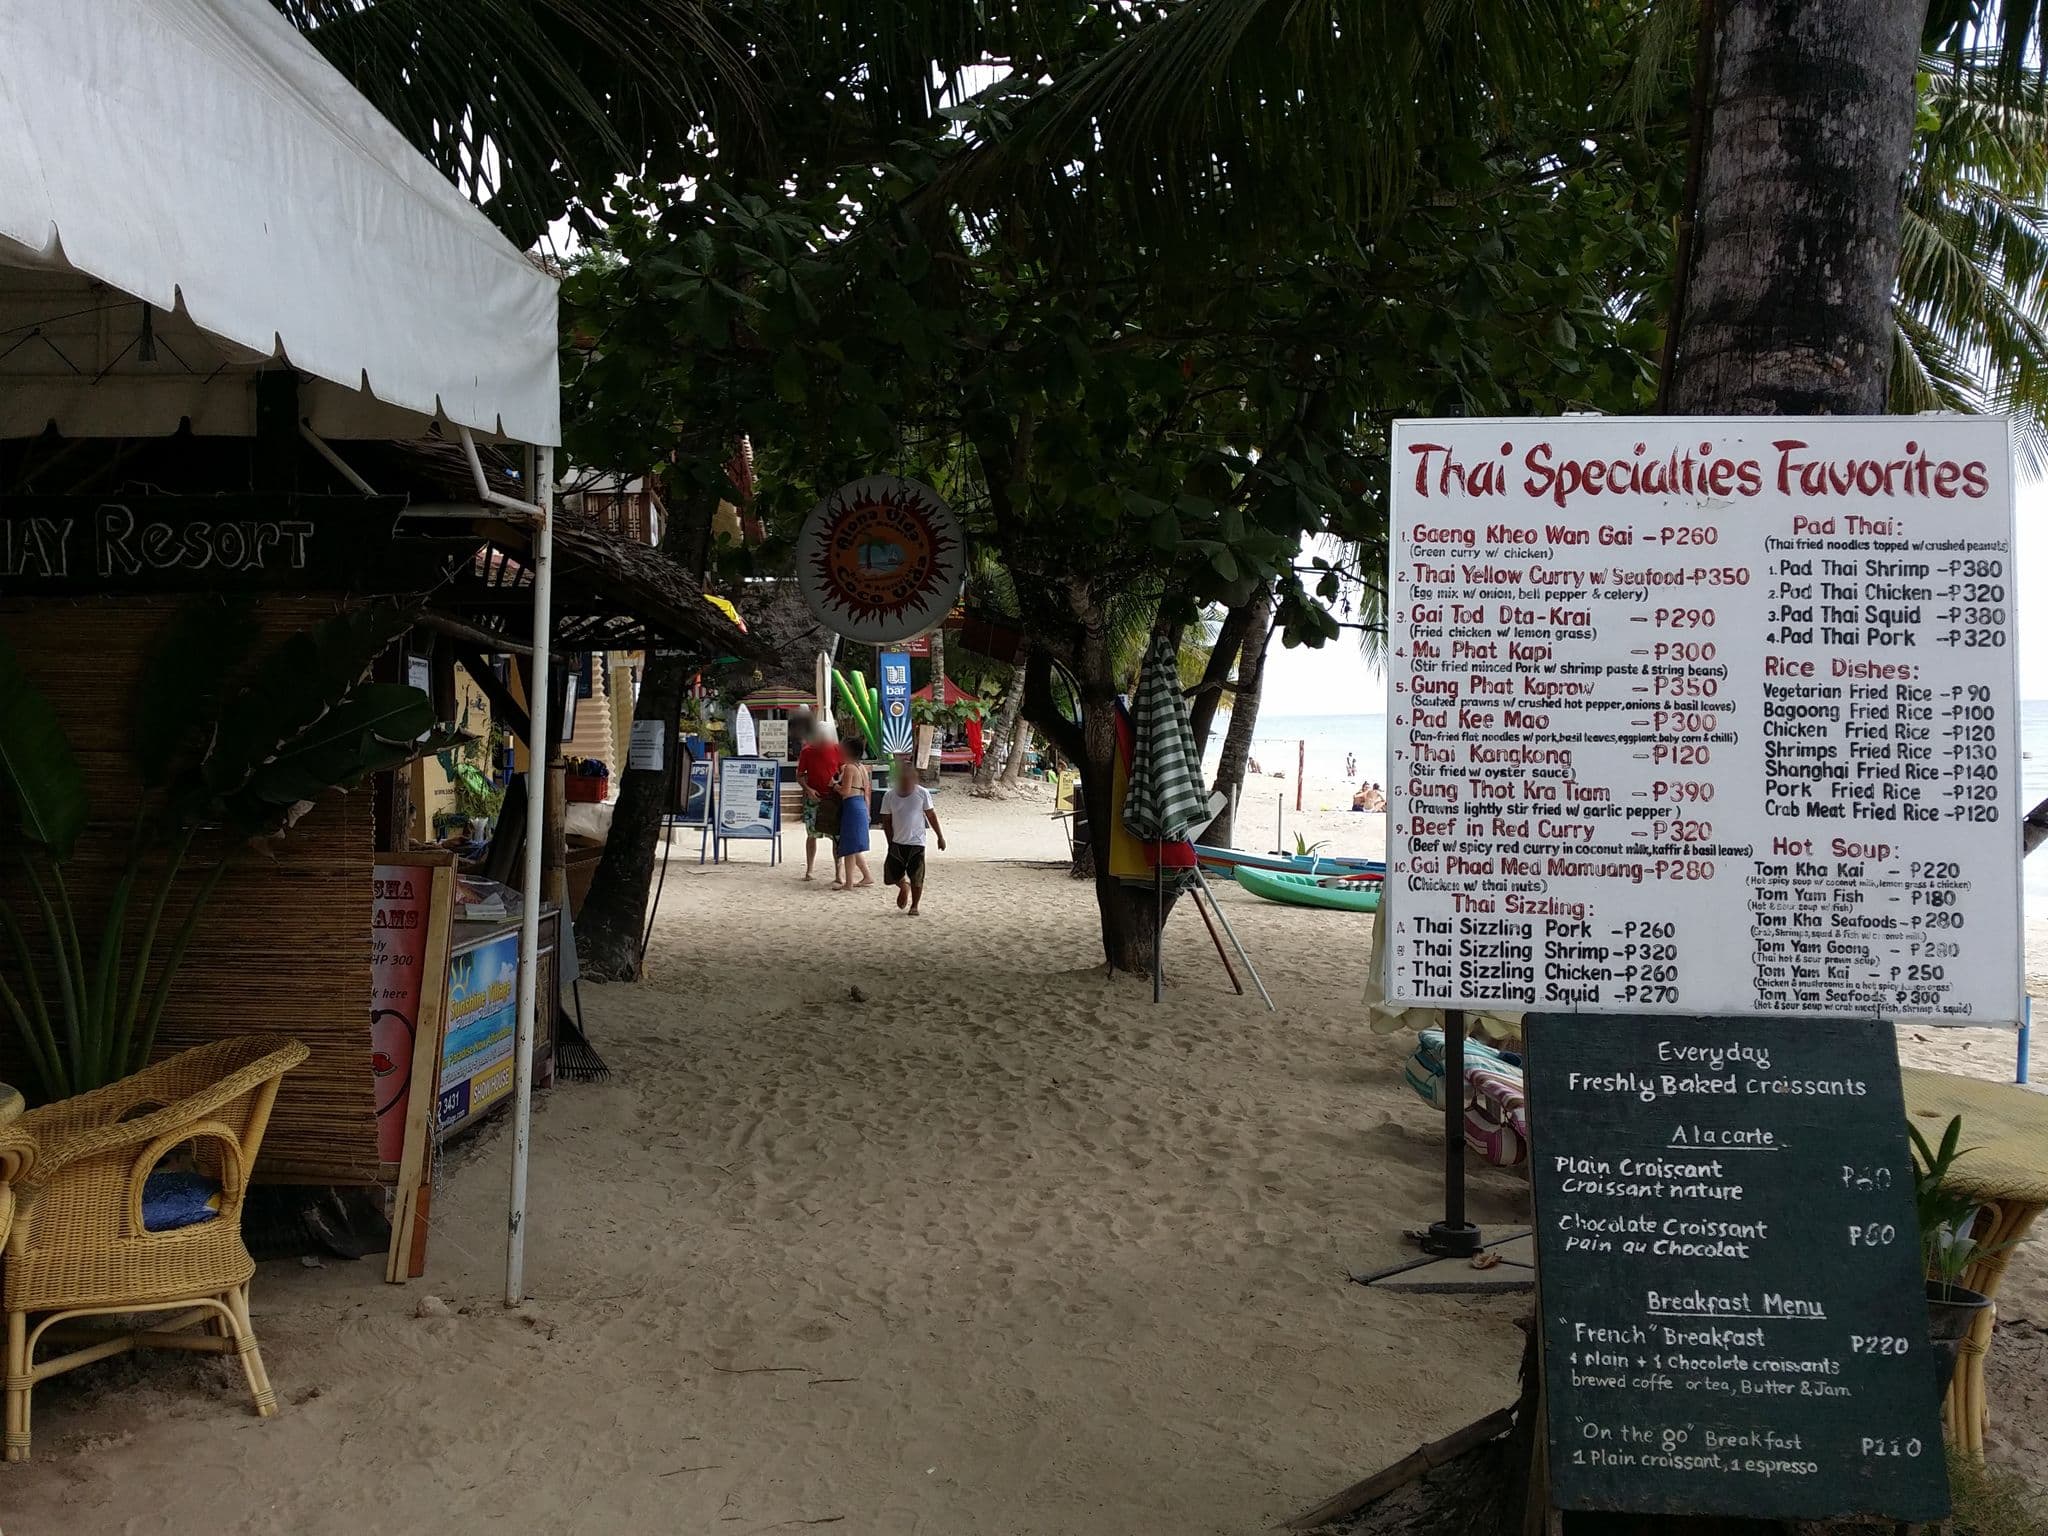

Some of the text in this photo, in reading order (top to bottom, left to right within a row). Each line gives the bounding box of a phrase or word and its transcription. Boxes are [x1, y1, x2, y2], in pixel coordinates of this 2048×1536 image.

[1408, 440, 1989, 508] Thai Specialties Favorites
[1793, 515, 1835, 535] Pad
[1413, 524, 1633, 548] Gaeng Kheo Wan Gai
[1827, 540, 1870, 550] noodles
[1874, 541, 1909, 552] topped
[1451, 549, 1480, 559] curry
[1413, 563, 1455, 583] Thai
[1462, 565, 1522, 584] Yellow
[1529, 565, 1585, 589] Curry
[1821, 560, 1929, 579] Thai Shrimp
[1519, 588, 1540, 599] bell
[1545, 590, 1587, 602] pepper
[1821, 583, 1932, 600] Thai Chicken
[1412, 604, 1442, 623] Gai
[1451, 605, 1484, 624] Tod
[1821, 606, 1920, 627] Thai Squid
[1449, 627, 1491, 638] chicken
[1515, 628, 1550, 638] lemon
[1821, 628, 1915, 647] Thai Pork
[1413, 641, 1552, 661] Mu Phat Kapi
[1765, 656, 1815, 677] Rice
[886, 686, 906, 695] bar
[1411, 676, 1595, 700] Gung Phat Kaprow
[1763, 683, 1932, 700] Vegetarian Fried Rice
[1412, 710, 1549, 729] Pad Kee Mao
[1764, 702, 1933, 722] Bagoong Fried Rice
[1413, 744, 1456, 762] Thai
[1765, 741, 1932, 760] Shrimps Fried Rice
[1409, 780, 1611, 802] Gung Thot Kra Tiam
[1412, 818, 1595, 842] Beef in Red Curry
[1774, 837, 1813, 856] Hot
[1411, 857, 1541, 876] Gai Phad Med
[1754, 861, 1864, 877] Tom Kha Kai
[1451, 893, 1495, 914] Thai
[391, 955, 413, 966] 300
[382, 988, 407, 999] here
[1412, 980, 1599, 1004] Thai Sizzling Squid
[1658, 1041, 1770, 1070] Everyday
[1569, 1073, 1656, 1102] Freshly
[1662, 1075, 1737, 1095] Baked
[1554, 1156, 1610, 1174] Plain
[1620, 1157, 1723, 1179] Croissant
[1562, 1175, 1743, 1200] Croissant nature
[1663, 1220, 1768, 1240] Croissant
[1623, 1241, 1647, 1253] au
[1647, 1290, 1825, 1317] Breakfast Menu
[1664, 1326, 1765, 1351] Breakfast
[1571, 1369, 1626, 1389] brewed
[1632, 1373, 1674, 1391] coffe
[1741, 1379, 1793, 1395] Butter
[1814, 1380, 1850, 1397] Jam
[1621, 1425, 1654, 1444] the
[1705, 1430, 1803, 1451] Breakfast
[1744, 1459, 1818, 1478] espresso
